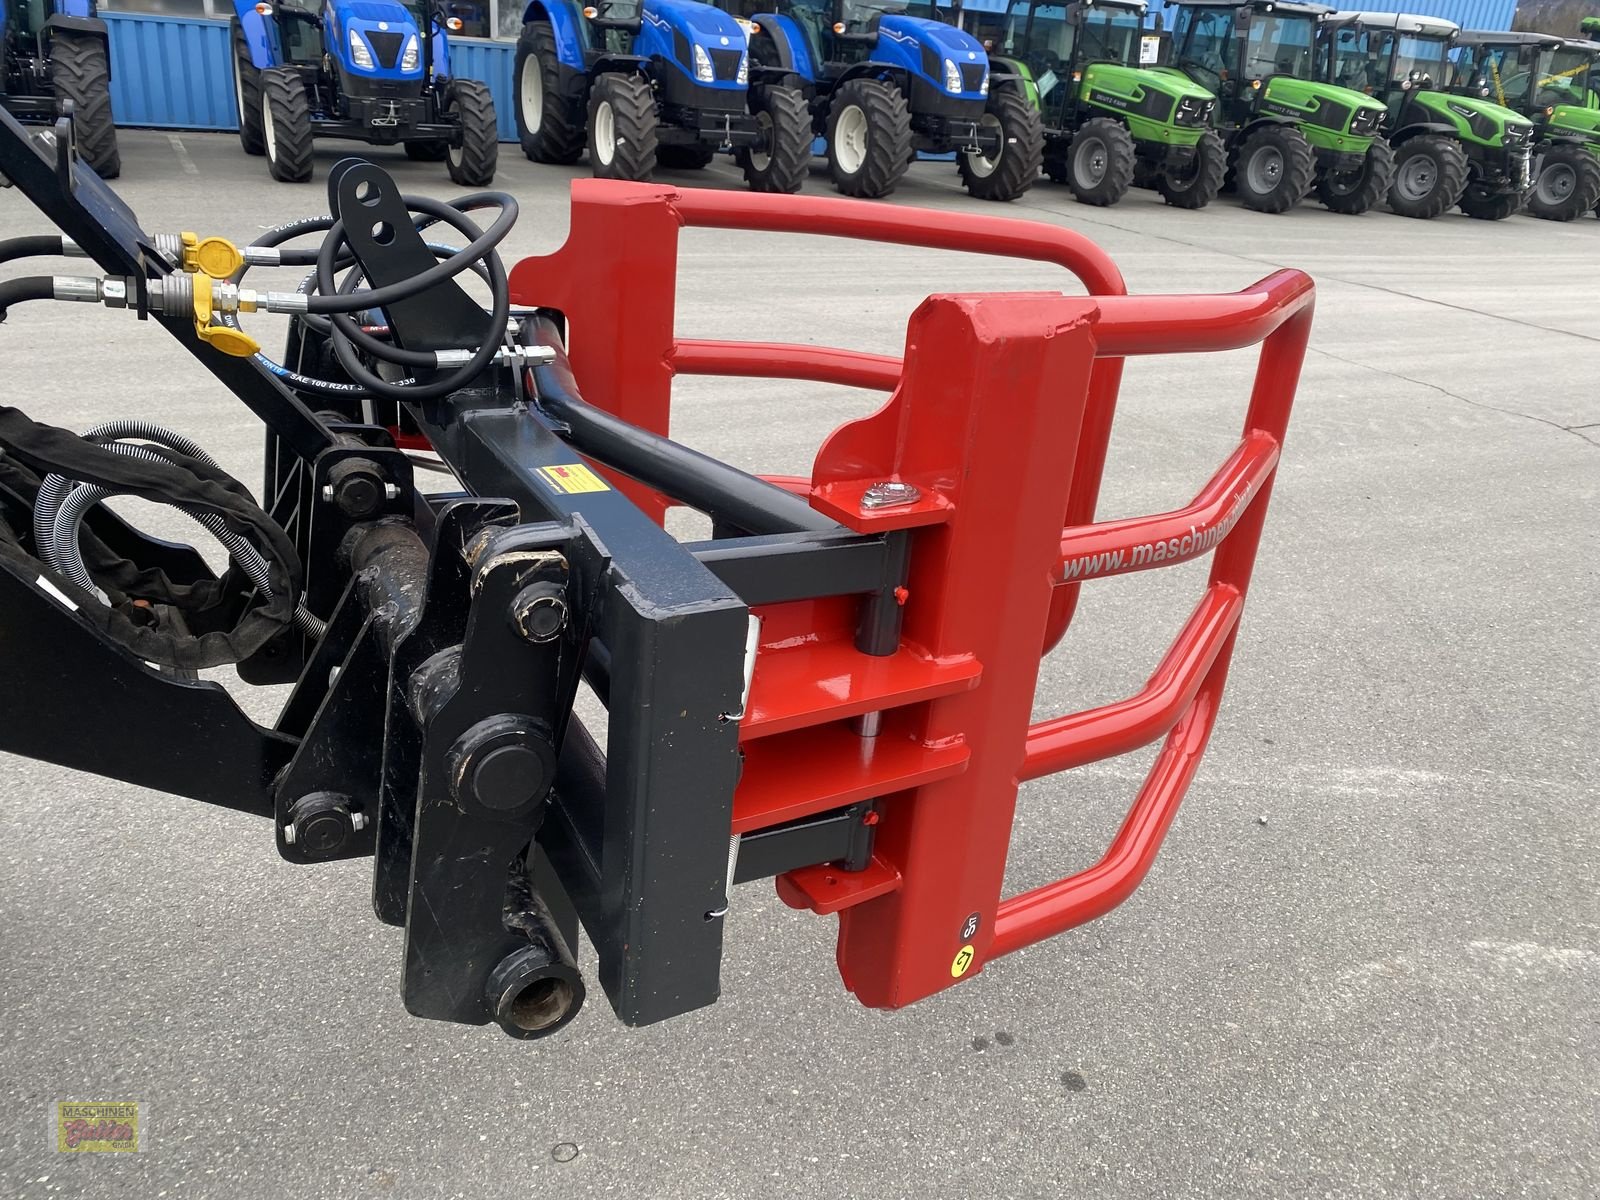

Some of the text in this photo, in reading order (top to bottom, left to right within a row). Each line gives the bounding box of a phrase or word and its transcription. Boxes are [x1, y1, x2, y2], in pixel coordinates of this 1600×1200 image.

[301, 215, 320, 223] BAR
[290, 373, 308, 384] SAE
[311, 379, 327, 388] 100
[329, 382, 355, 391] R2AT
[398, 377, 416, 387] 330
